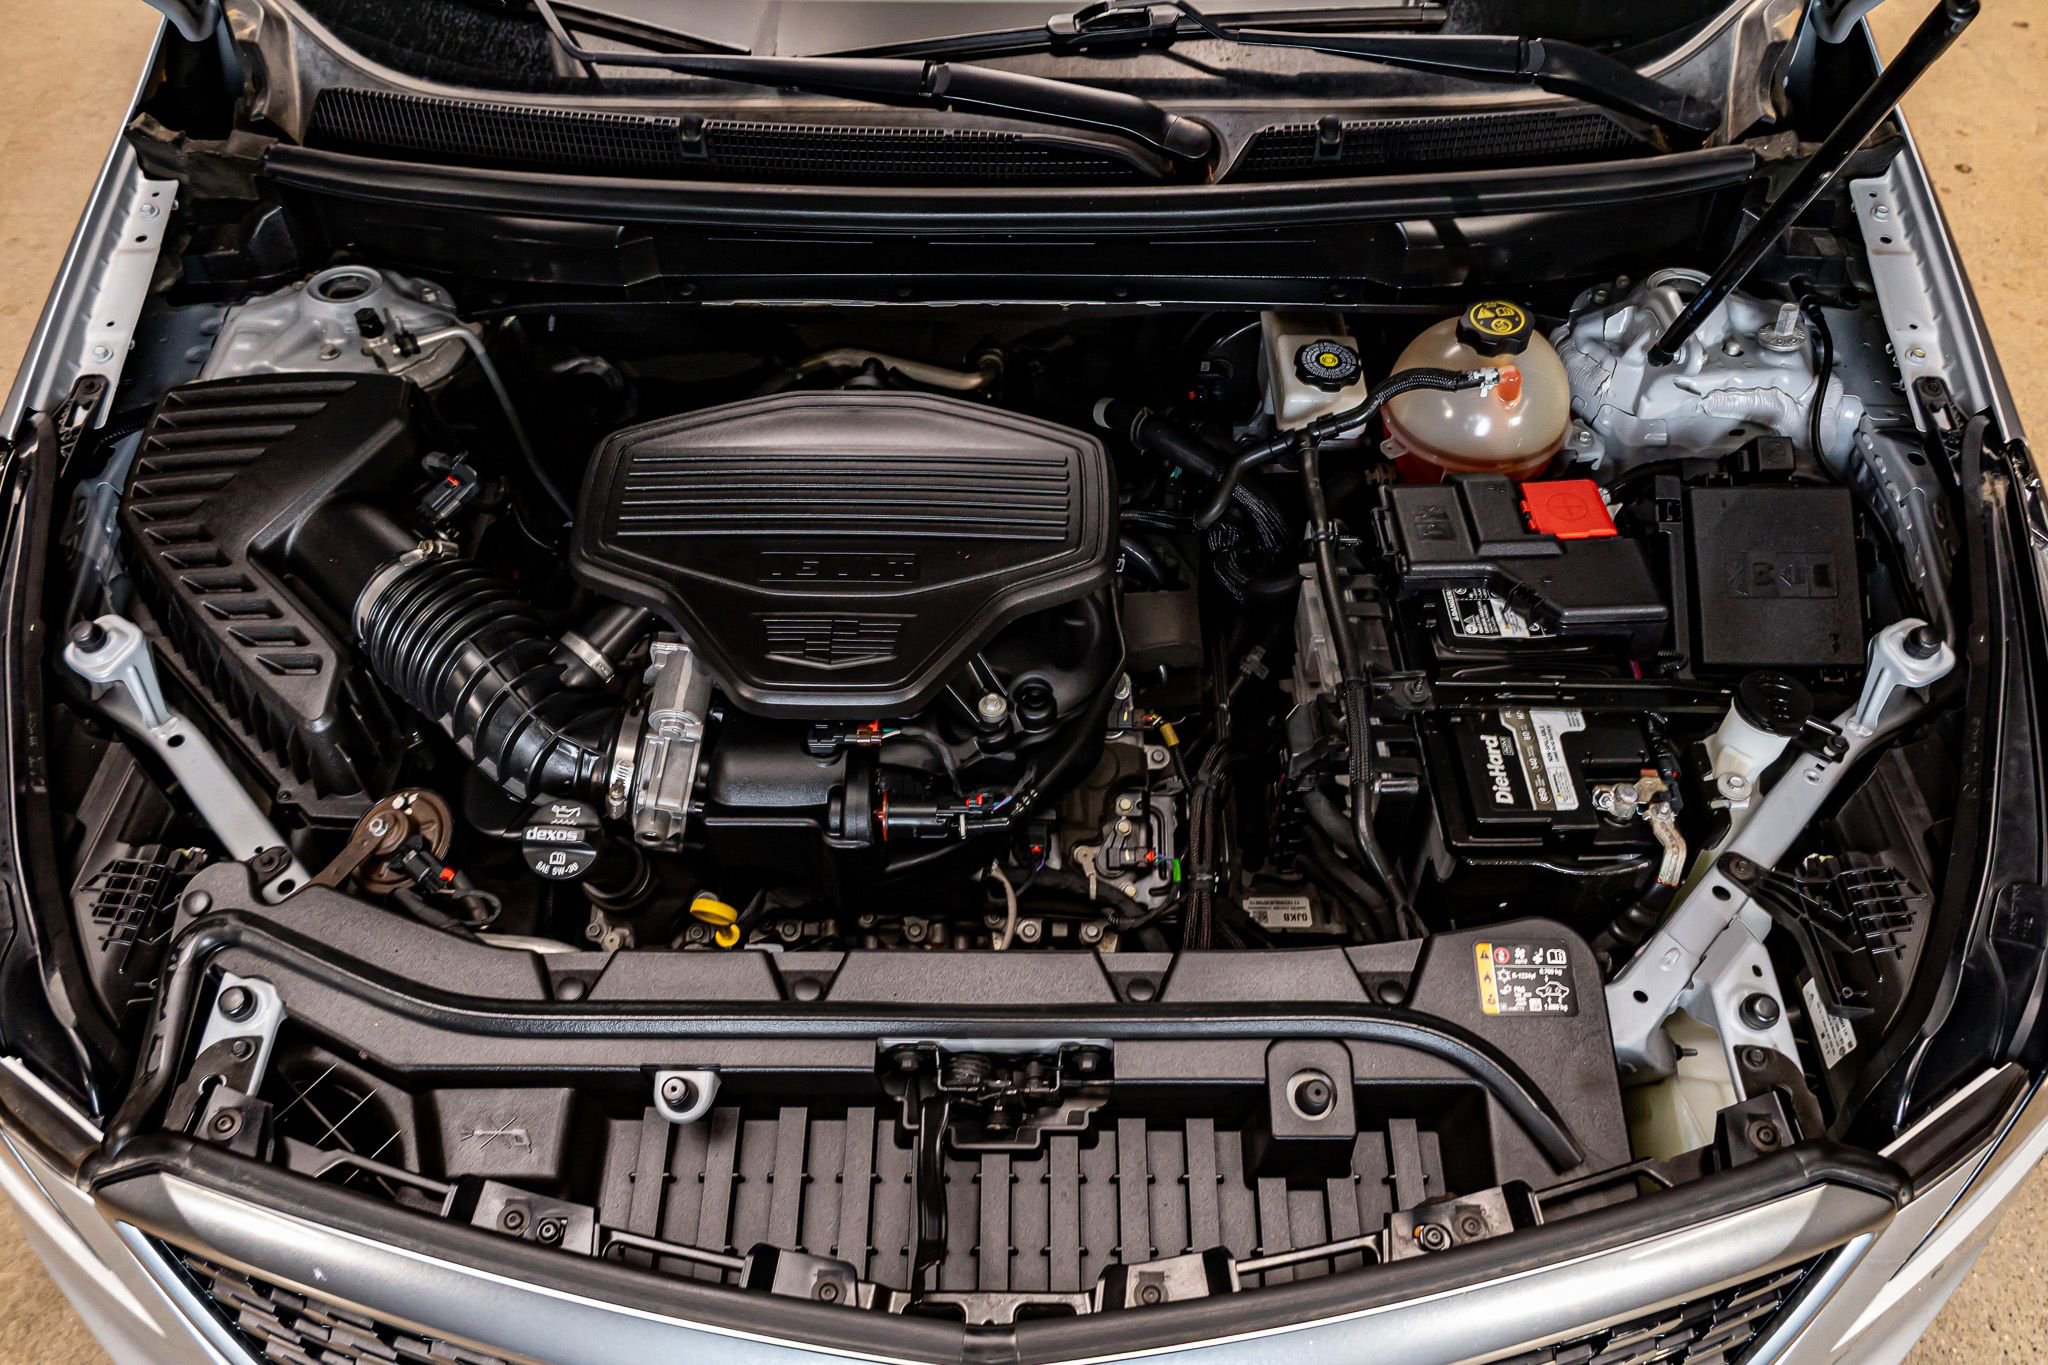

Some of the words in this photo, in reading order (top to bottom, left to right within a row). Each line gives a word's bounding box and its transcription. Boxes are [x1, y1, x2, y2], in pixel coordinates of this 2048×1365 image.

[1480, 734, 1514, 805] DieHard
[526, 826, 578, 841] dexos
[535, 860, 551, 874] SAE
